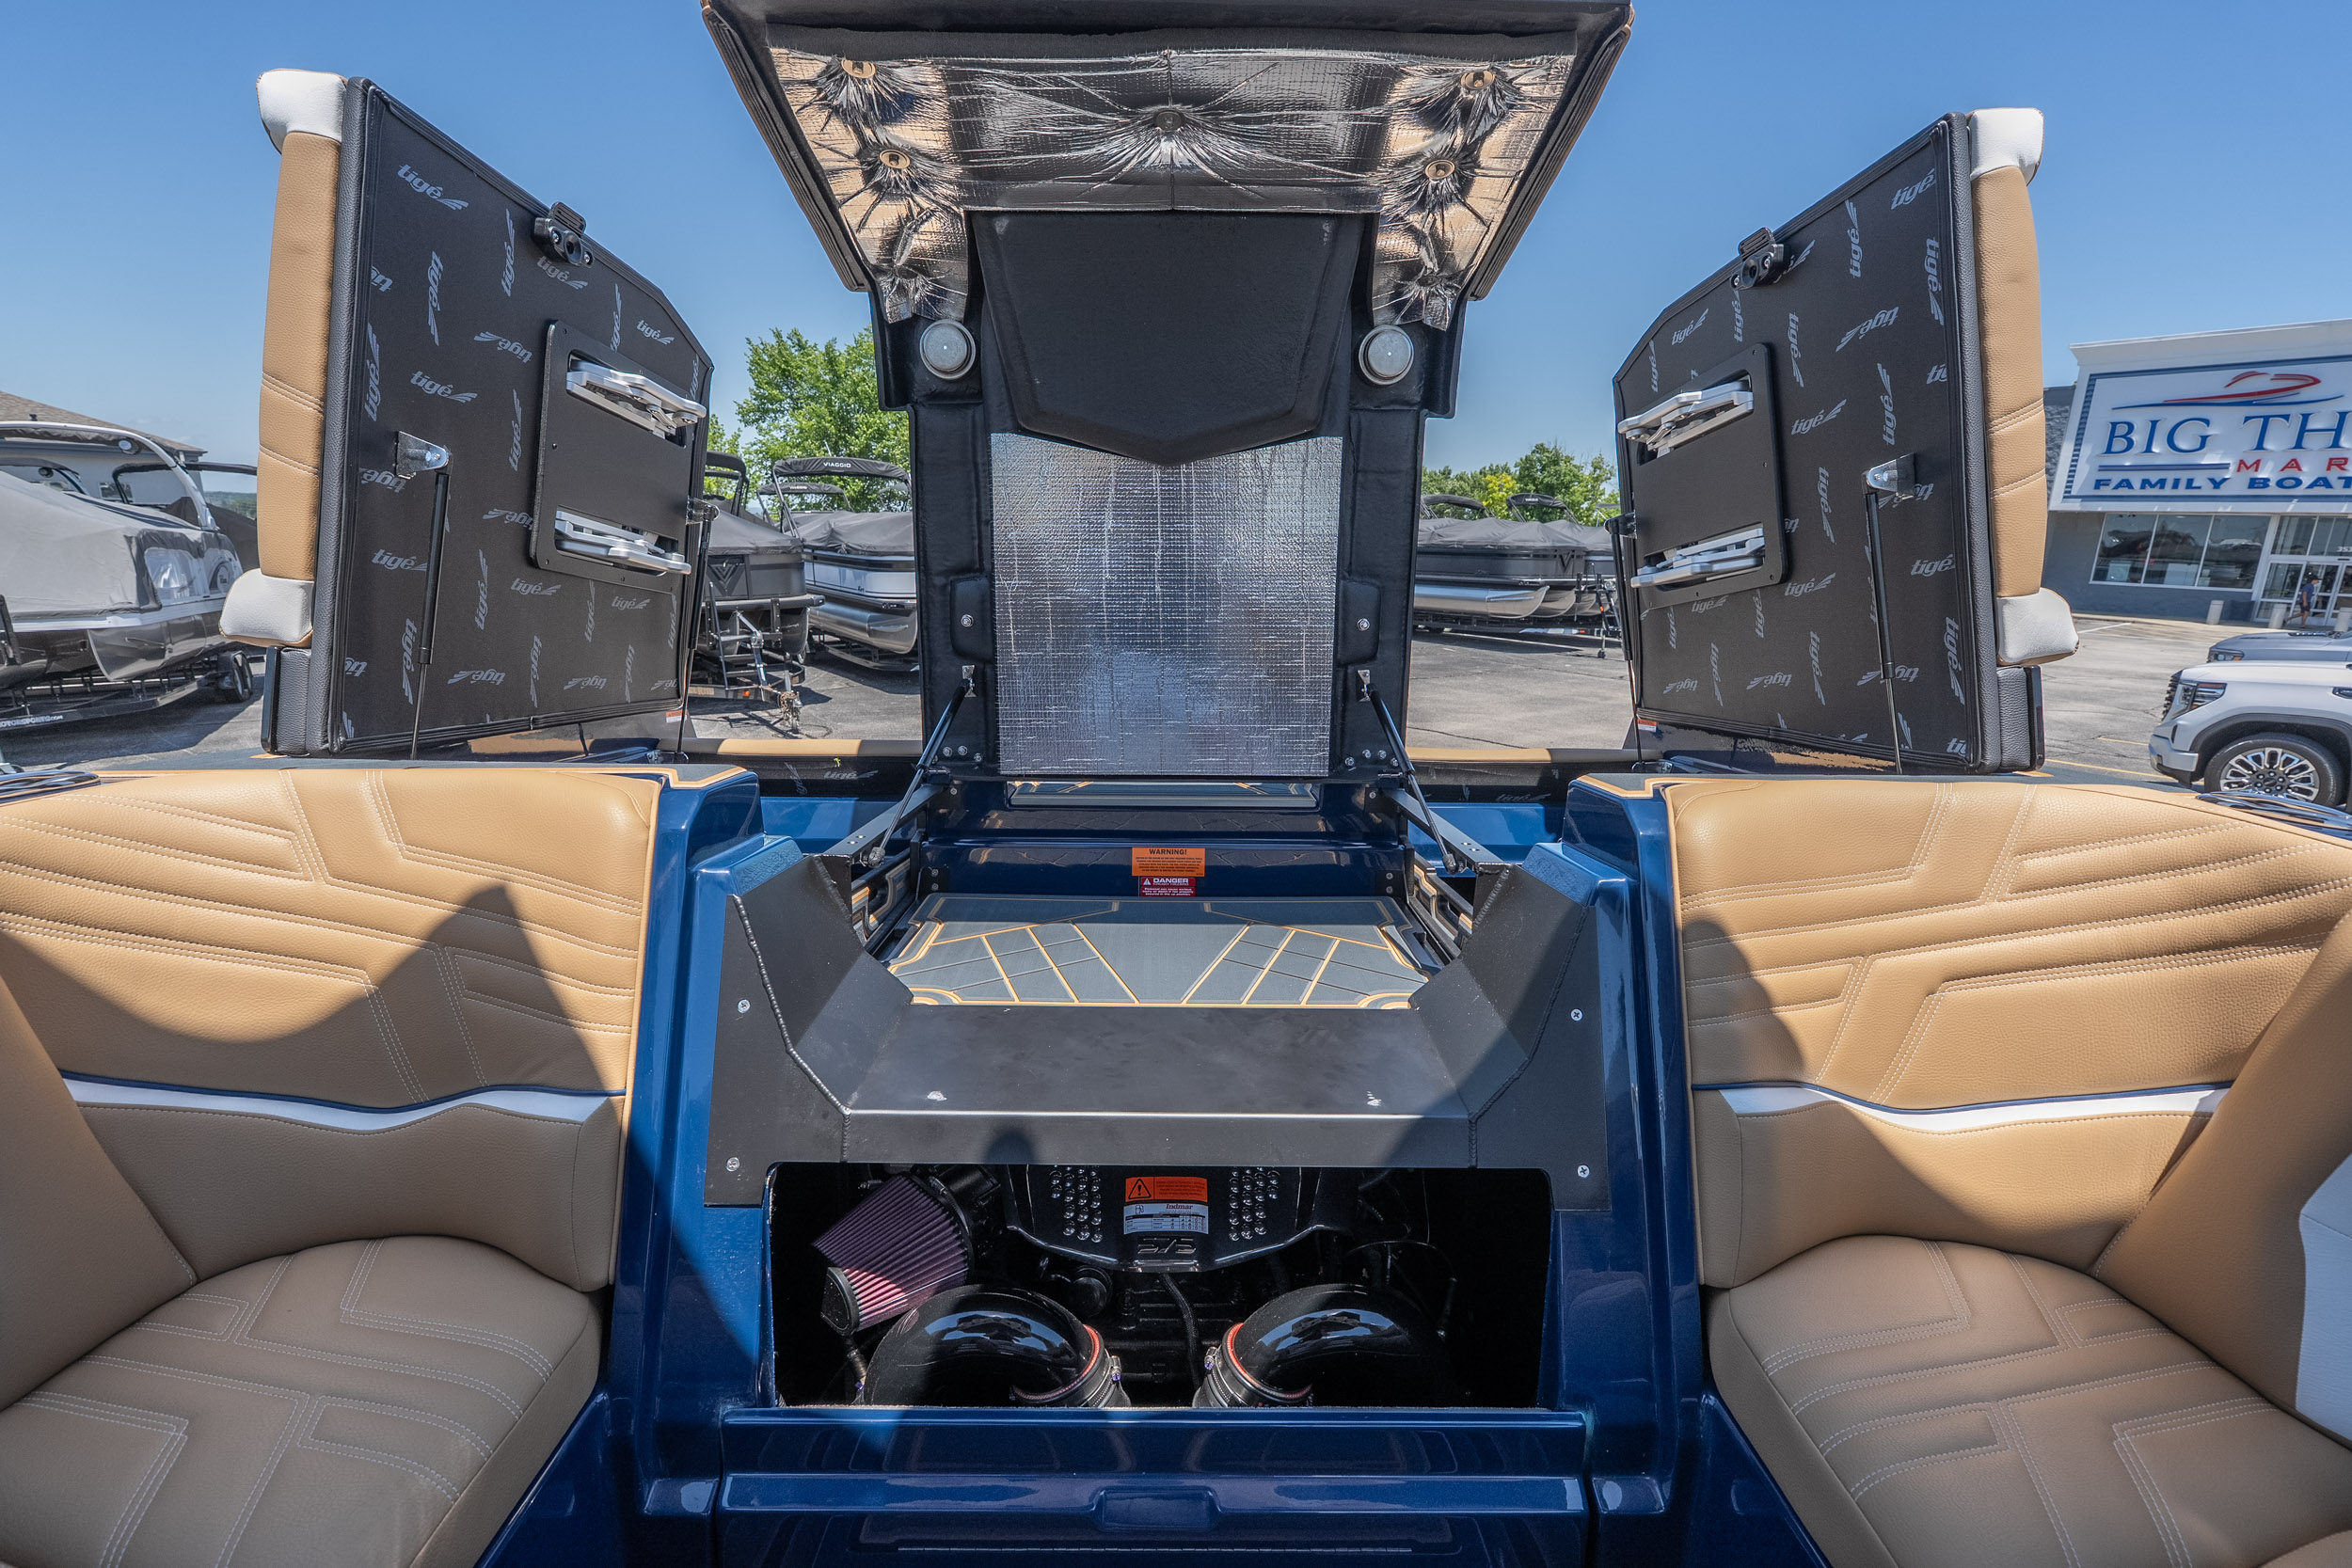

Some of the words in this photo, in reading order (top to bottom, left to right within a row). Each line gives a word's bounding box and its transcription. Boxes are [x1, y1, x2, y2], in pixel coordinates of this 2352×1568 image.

[2099, 417, 2212, 455] BIG
[2242, 411, 2352, 451] TH
[2236, 457, 2349, 473] MAR
[2093, 477, 2231, 490] FAMILY
